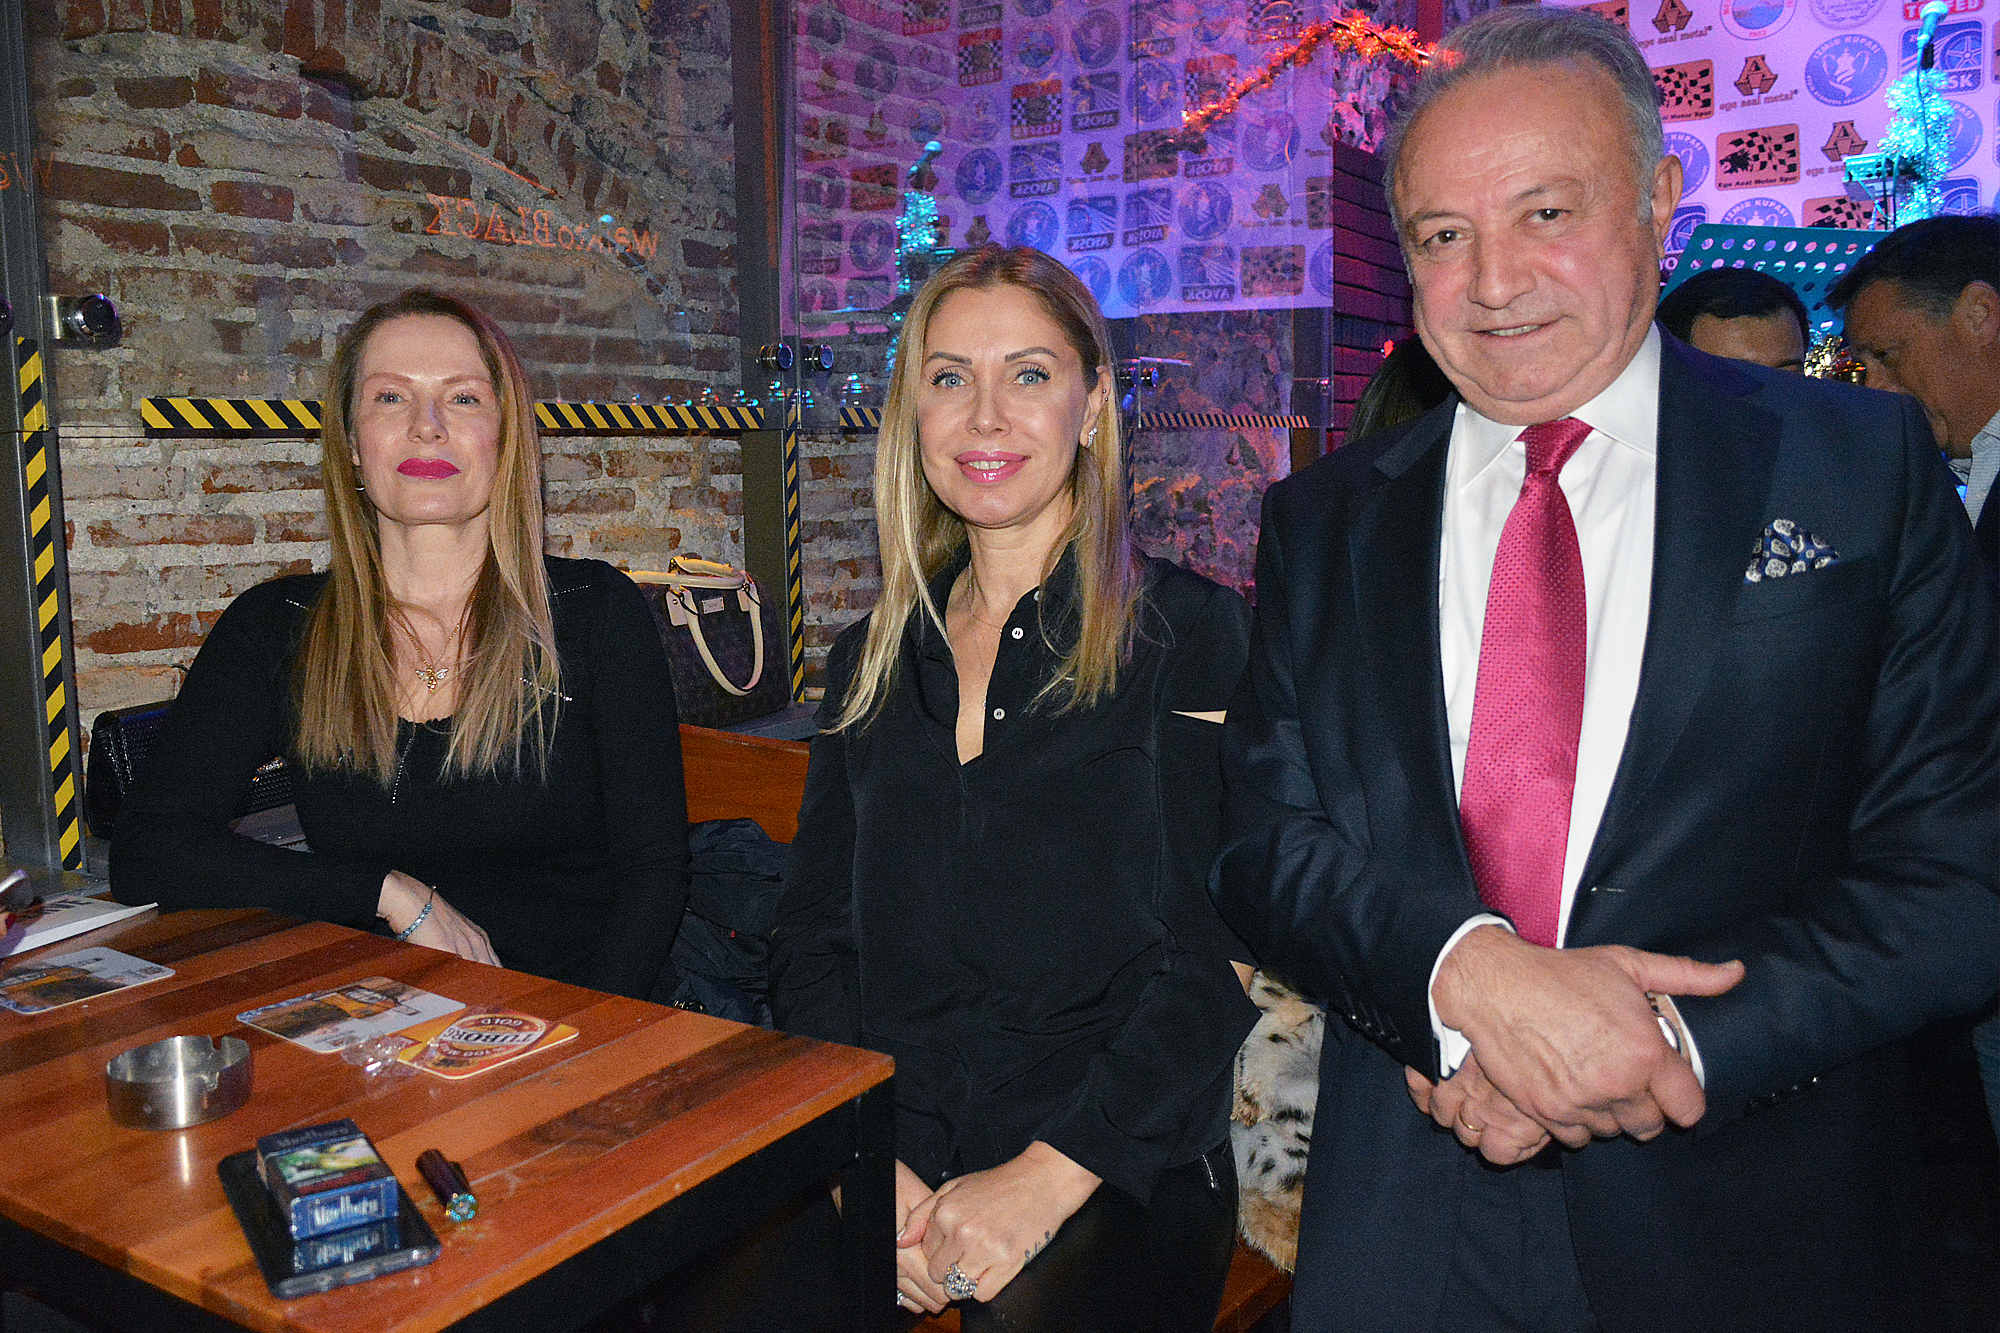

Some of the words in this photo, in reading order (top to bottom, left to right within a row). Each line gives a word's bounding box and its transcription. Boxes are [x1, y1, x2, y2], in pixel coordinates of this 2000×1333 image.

[1906, 0, 1980, 19] TFED
[480, 1017, 523, 1027] GOLD
[442, 1028, 534, 1044] TUBORG
